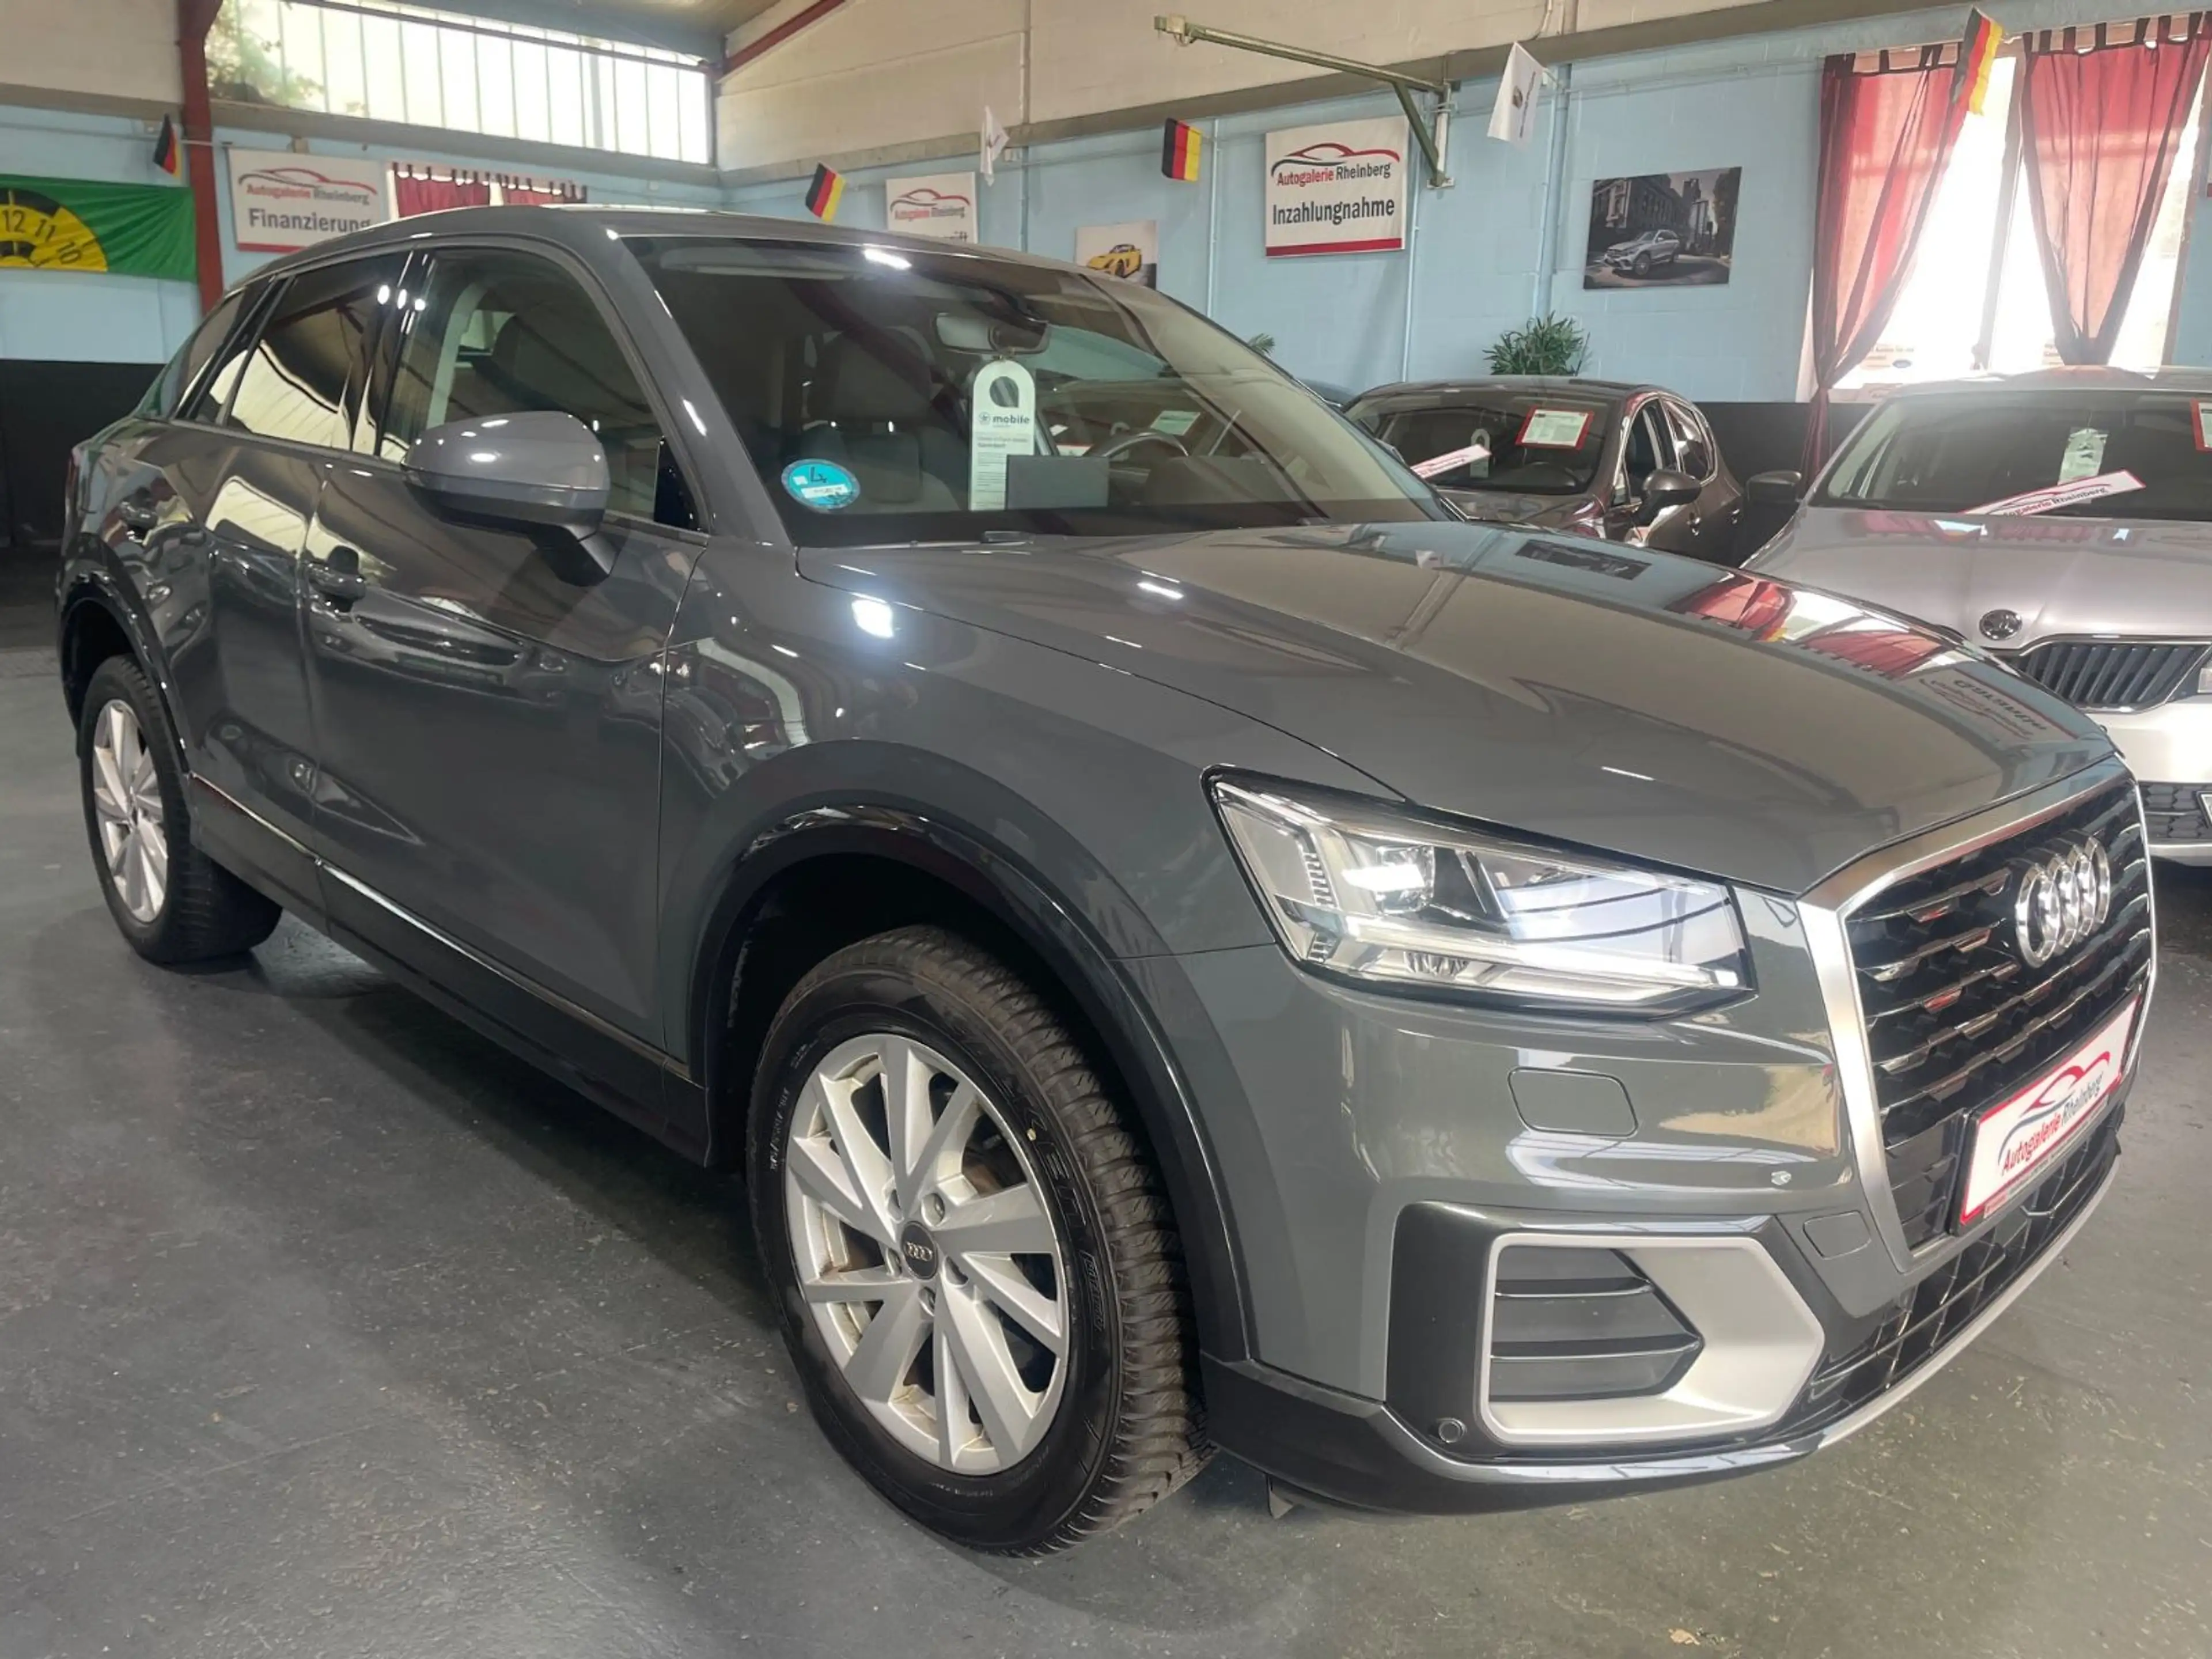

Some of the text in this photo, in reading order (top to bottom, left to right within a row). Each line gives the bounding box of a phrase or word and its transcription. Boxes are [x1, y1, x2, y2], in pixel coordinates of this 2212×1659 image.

[1277, 162, 1391, 187] Autogalerie Rheinberg
[246, 183, 370, 206] Autogalerie Rheinberg
[248, 207, 371, 232] Finanzierung
[1272, 196, 1395, 225] Inzahlungnahme
[1, 209, 82, 266] 12 11 10
[993, 414, 1030, 425] mobile
[810, 466, 828, 483] 4
[2001, 1112, 2062, 1177] Autogalerie
